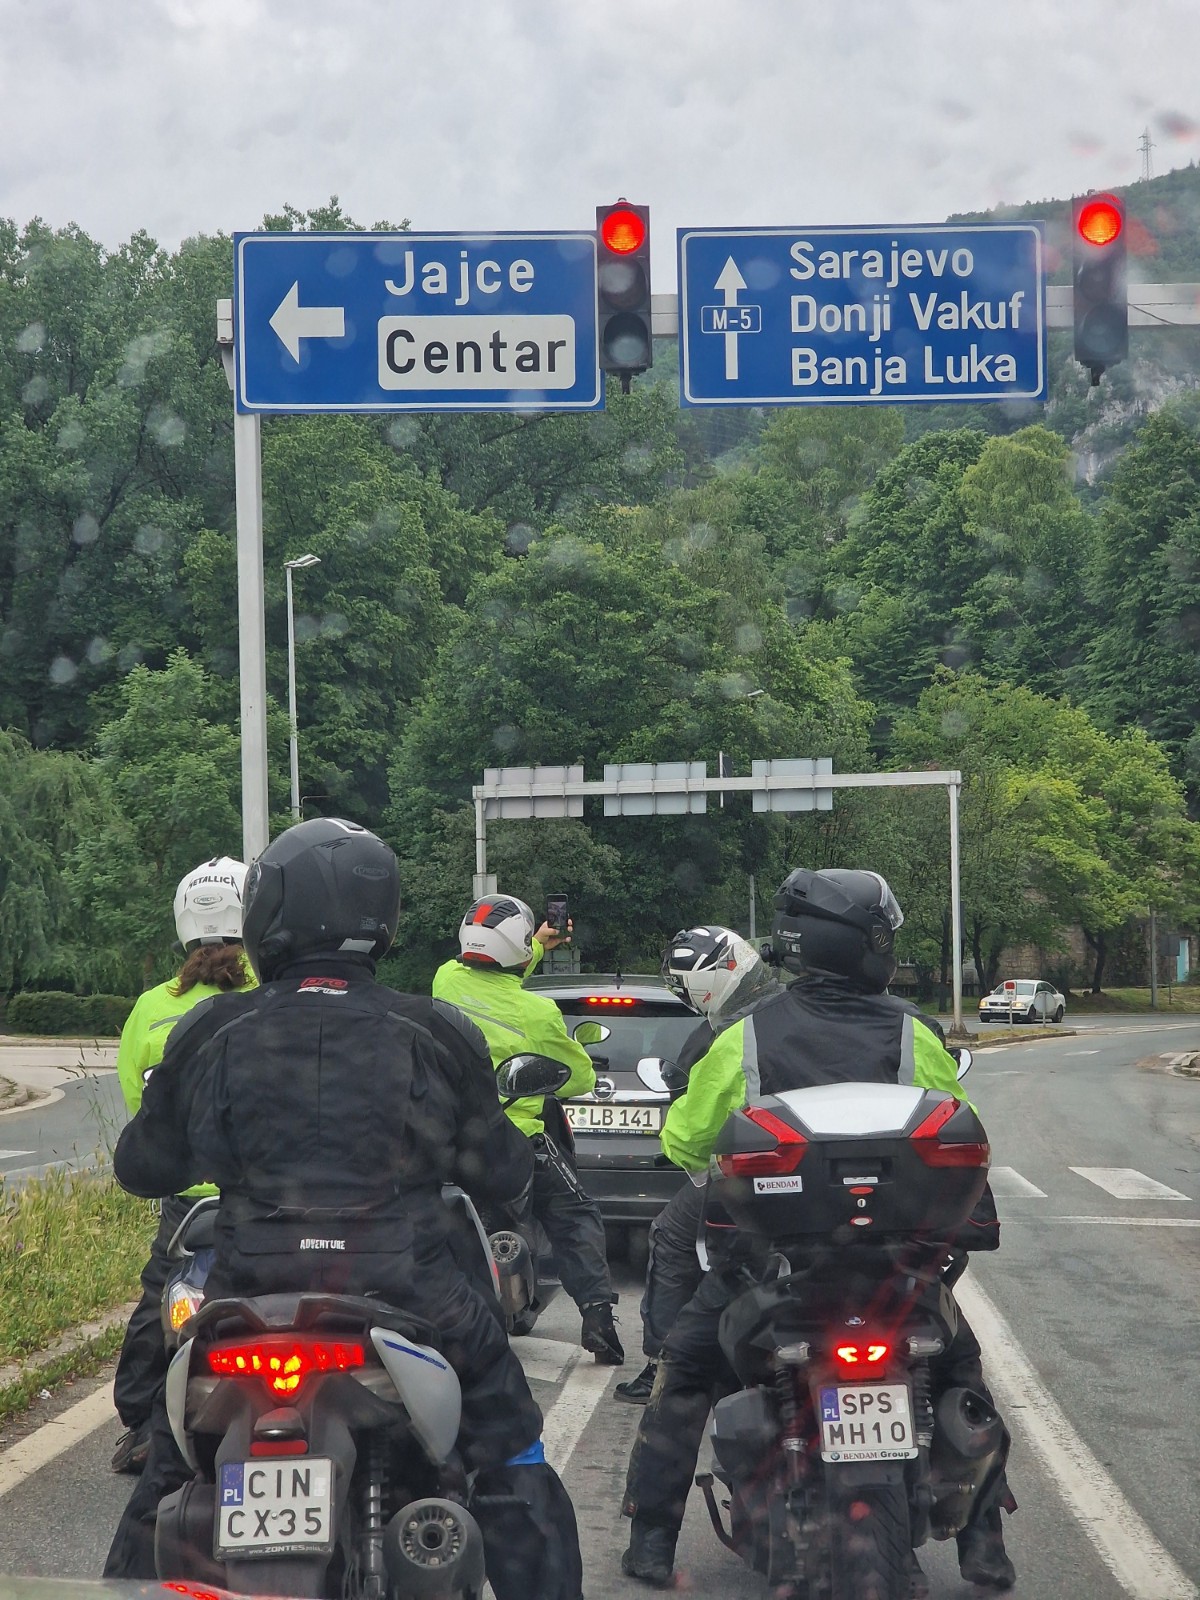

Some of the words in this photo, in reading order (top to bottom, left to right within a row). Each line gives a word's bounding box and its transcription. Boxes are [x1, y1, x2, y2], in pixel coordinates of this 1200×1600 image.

[789, 240, 974, 287] Sarajevo
[384, 250, 535, 306] Jajce
[712, 309, 752, 330] M-5
[790, 294, 891, 342] Donji
[909, 290, 1026, 331] Vakuf
[386, 328, 567, 374] Centar
[791, 347, 907, 395] Banja
[924, 343, 1017, 384] Luka
[590, 1108, 613, 1126] LB
[619, 1109, 653, 1127] 141
[765, 1179, 799, 1189] BENDAM
[299, 1238, 346, 1250] ADVENTURE
[824, 1408, 838, 1419] PL
[842, 1391, 893, 1416] SPS
[829, 1421, 906, 1446] MH10
[843, 1452, 877, 1460] BENDAM
[880, 1450, 910, 1459] Group
[223, 1488, 242, 1503] PL
[248, 1468, 311, 1499] CIN
[227, 1507, 322, 1538] CX35
